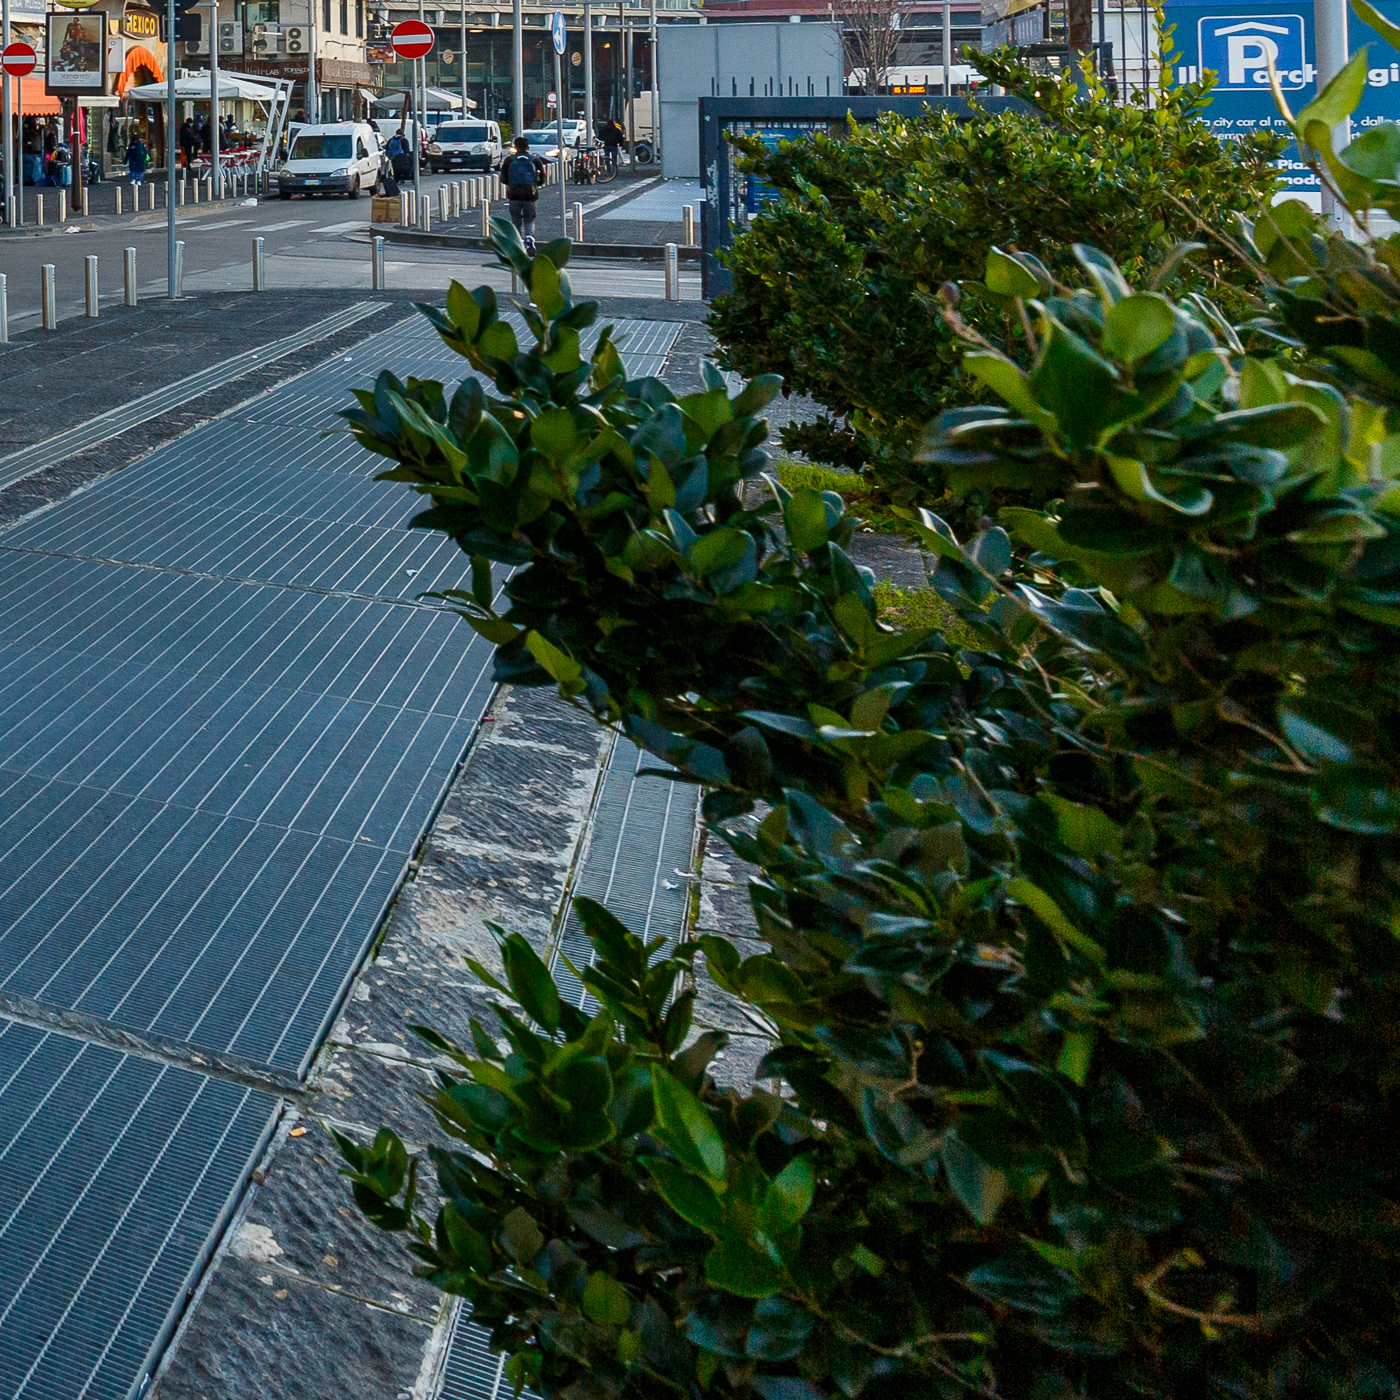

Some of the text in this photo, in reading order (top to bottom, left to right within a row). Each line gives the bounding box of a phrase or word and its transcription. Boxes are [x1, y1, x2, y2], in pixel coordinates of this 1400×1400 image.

[126, 13, 156, 35] MEXICO
[1213, 117, 1234, 129] city
[1236, 119, 1257, 127] car
[1259, 116, 1271, 127] al
